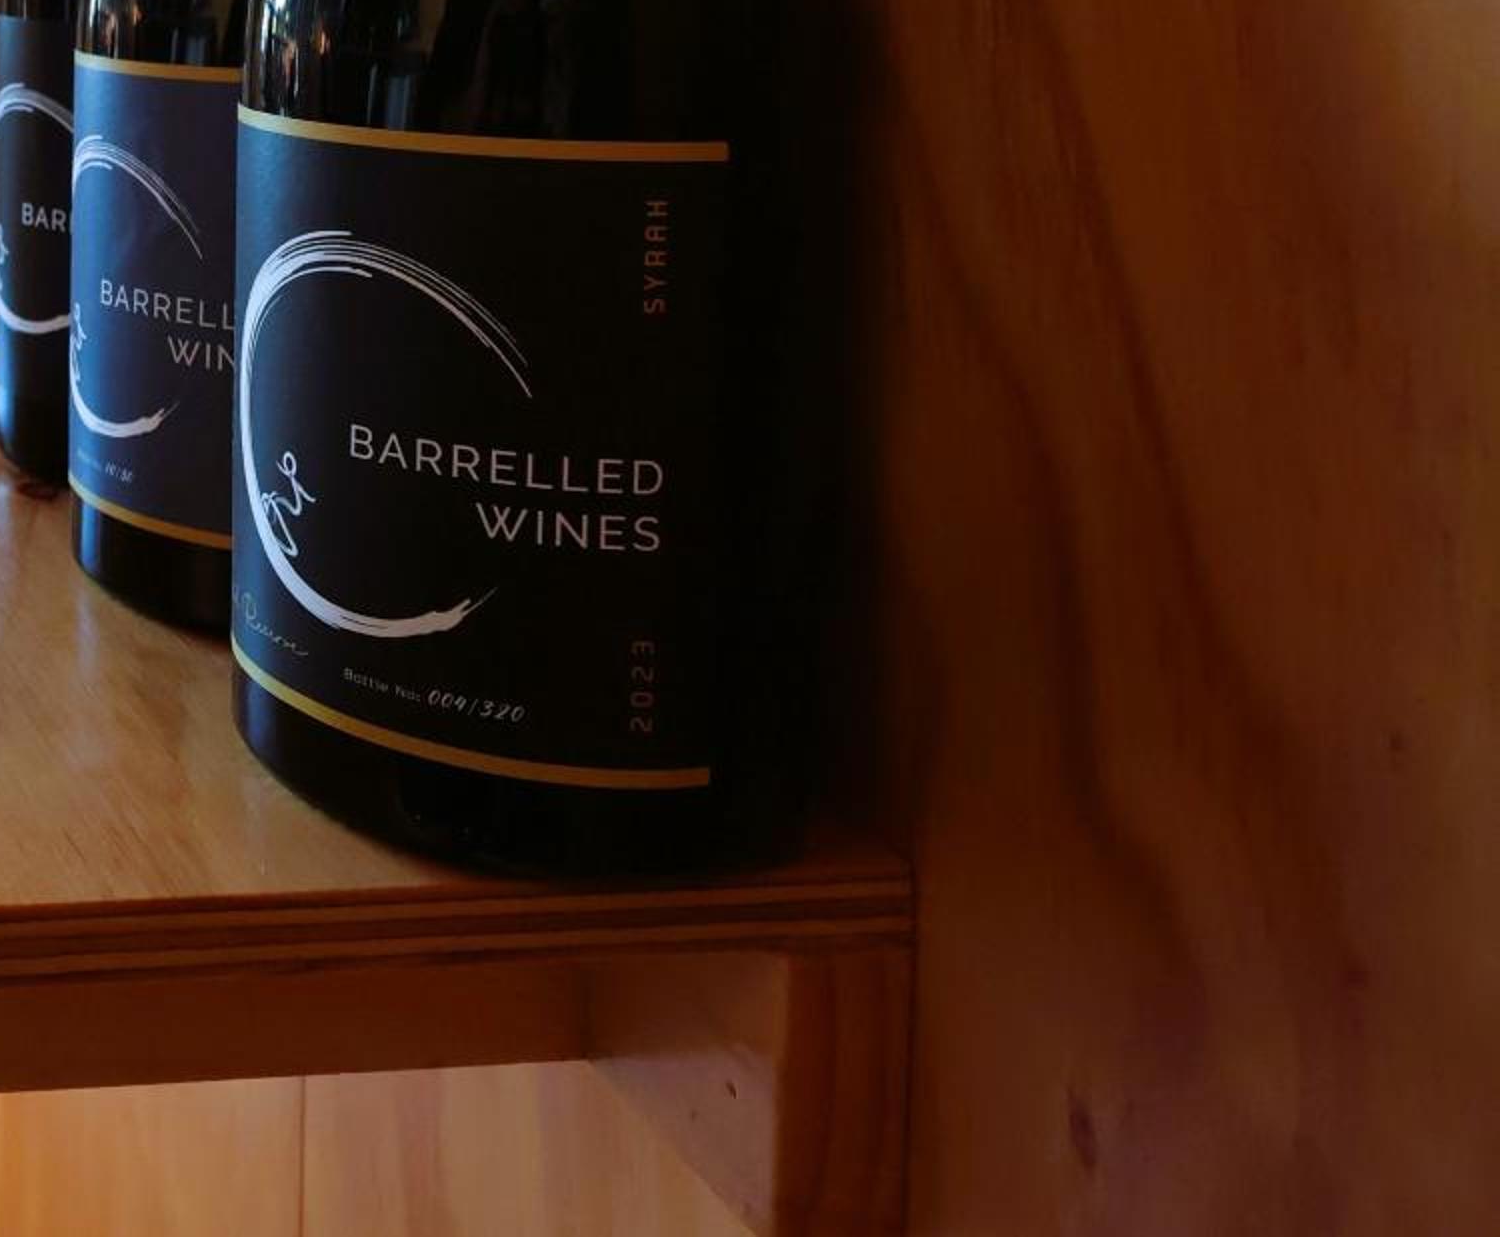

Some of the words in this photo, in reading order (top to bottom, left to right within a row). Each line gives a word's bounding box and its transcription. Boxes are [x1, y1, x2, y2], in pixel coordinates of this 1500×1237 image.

[21, 202, 72, 232] BAR
[643, 200, 668, 314] SYRAH
[99, 278, 235, 330] BARRELL
[349, 424, 663, 495] BARRELLED
[475, 502, 660, 551] WINES
[629, 641, 655, 732] 2023
